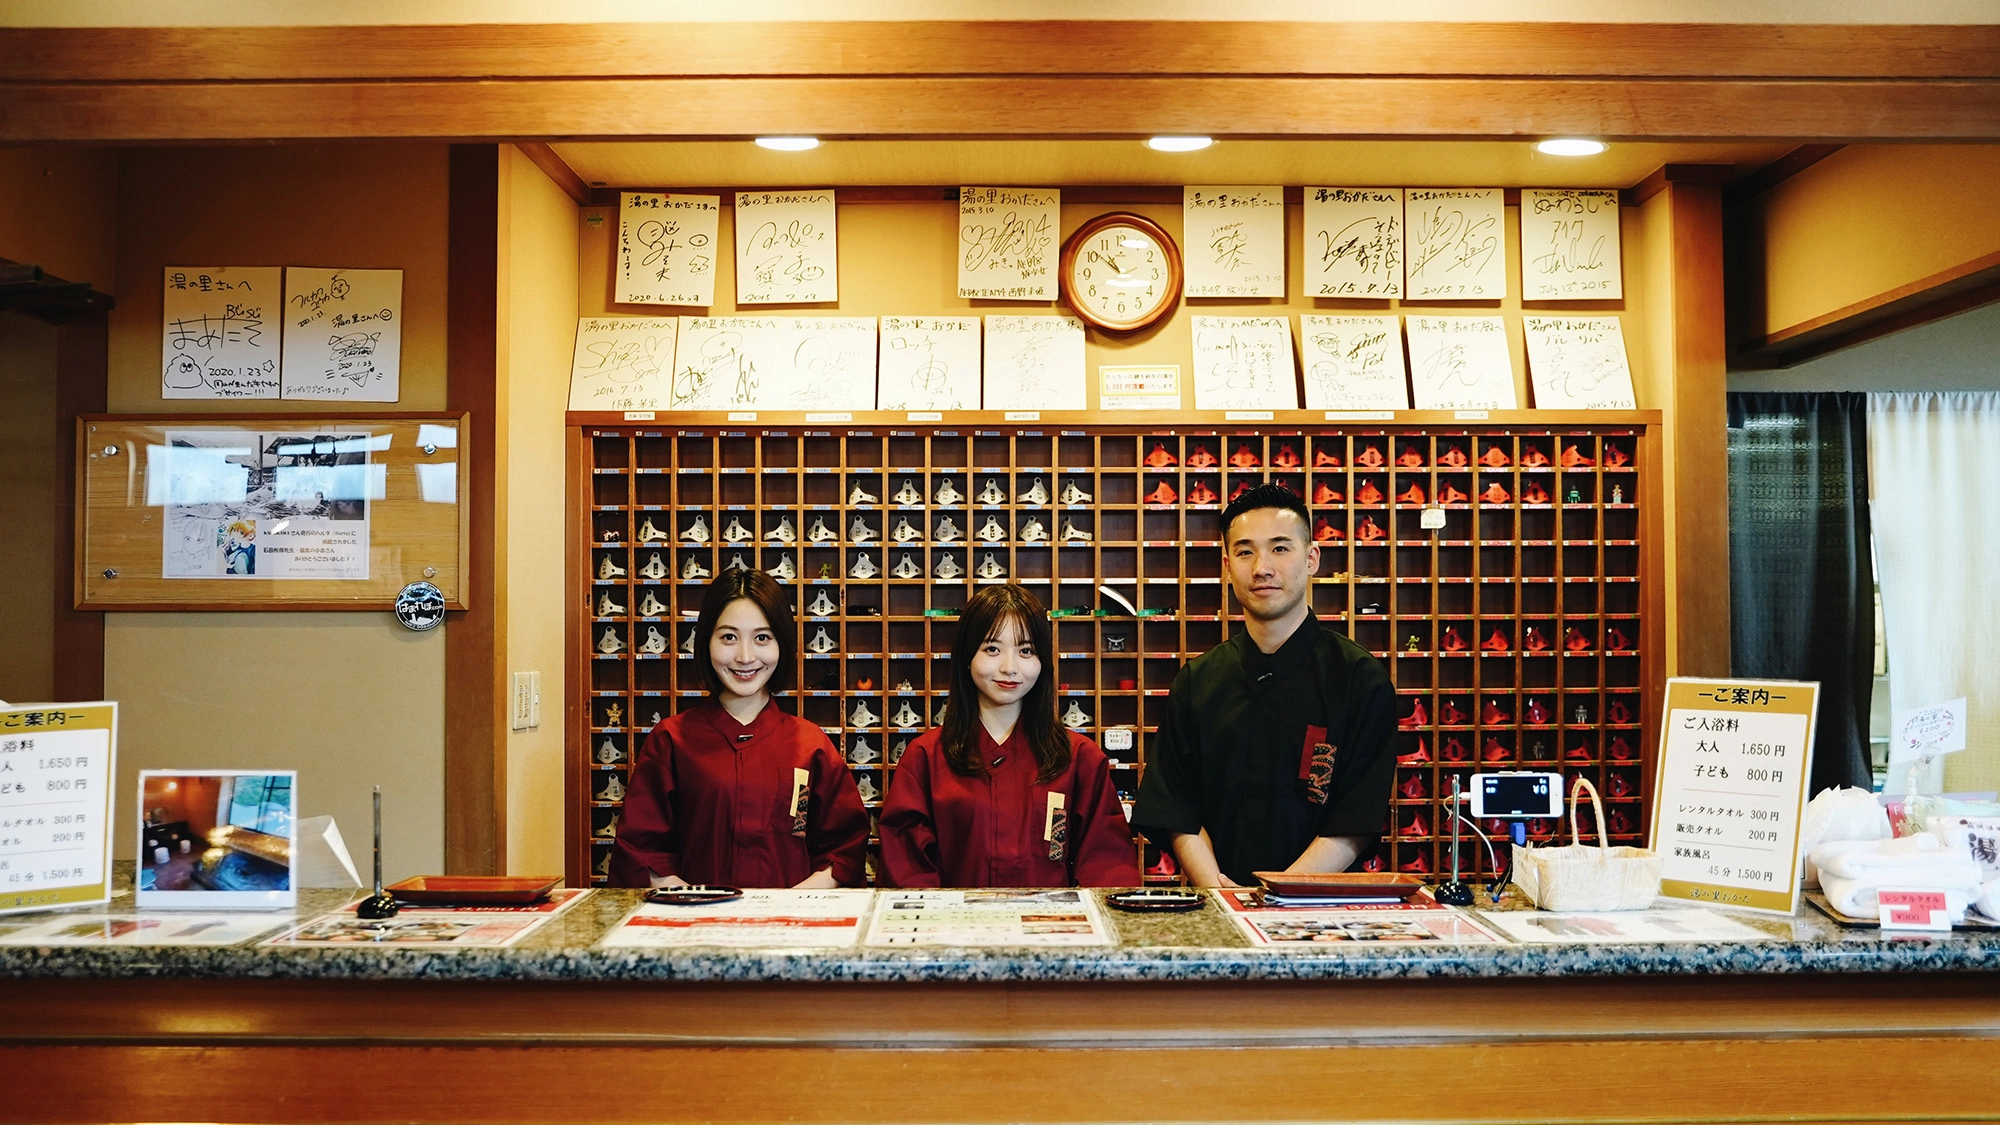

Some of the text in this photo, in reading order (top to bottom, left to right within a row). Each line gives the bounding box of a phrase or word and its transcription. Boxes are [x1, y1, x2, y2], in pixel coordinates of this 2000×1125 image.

[1146, 250, 1154, 263] 2
[1083, 267, 1092, 280] 9
[1151, 267, 1160, 280] 3
[1088, 284, 1097, 297] 8
[1145, 285, 1154, 297] 4
[1101, 296, 1109, 309] 7
[1117, 301, 1126, 313] 6
[1134, 297, 1142, 309] 5
[1684, 717, 1739, 732] ご入浴料
[1695, 740, 1720, 753] 大人
[1694, 765, 1729, 778] 子ども
[1679, 804, 1744, 818] レンタルタオル
[1676, 823, 1723, 836] 販売タオル
[1674, 846, 1711, 860] 家族風呂
[1885, 895, 1940, 903] レンタルタオル
